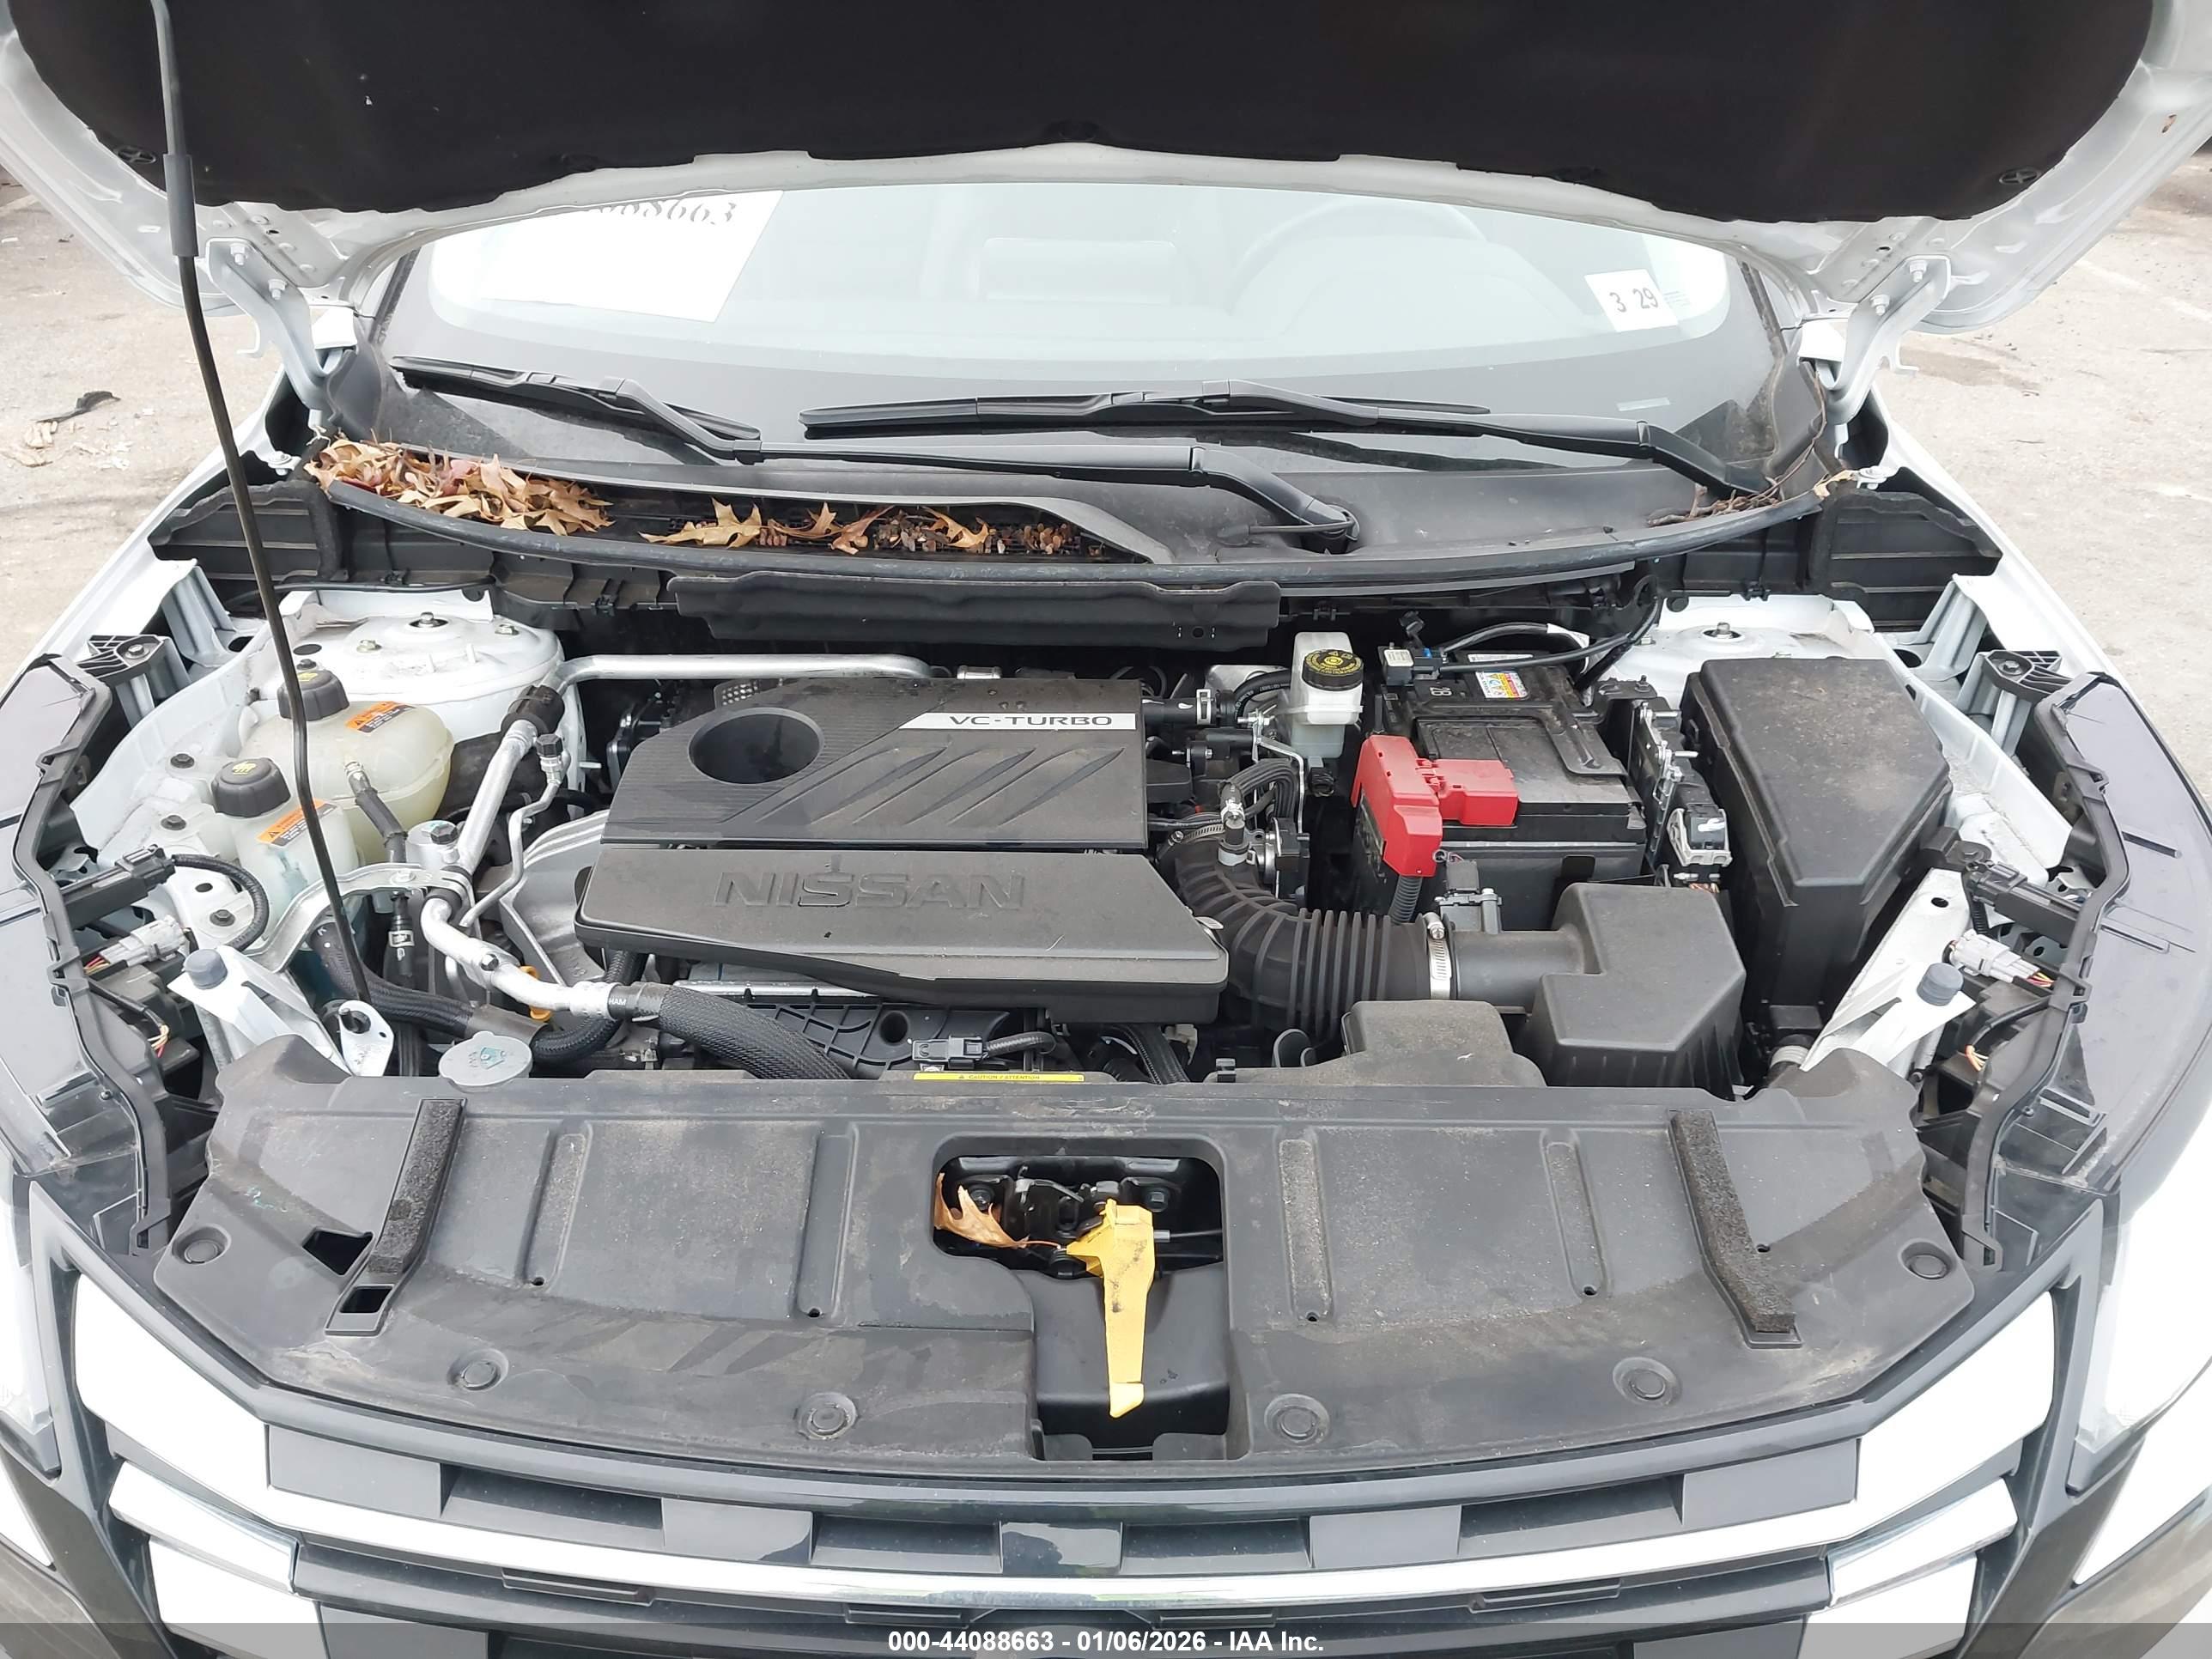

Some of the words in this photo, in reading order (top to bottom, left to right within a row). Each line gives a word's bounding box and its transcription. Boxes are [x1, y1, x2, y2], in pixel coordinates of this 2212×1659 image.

[1609, 292, 1627, 313] 3
[1632, 288, 1659, 309] 29
[950, 716, 1112, 726] VC-TURBO
[713, 871, 1025, 909] NISSAN
